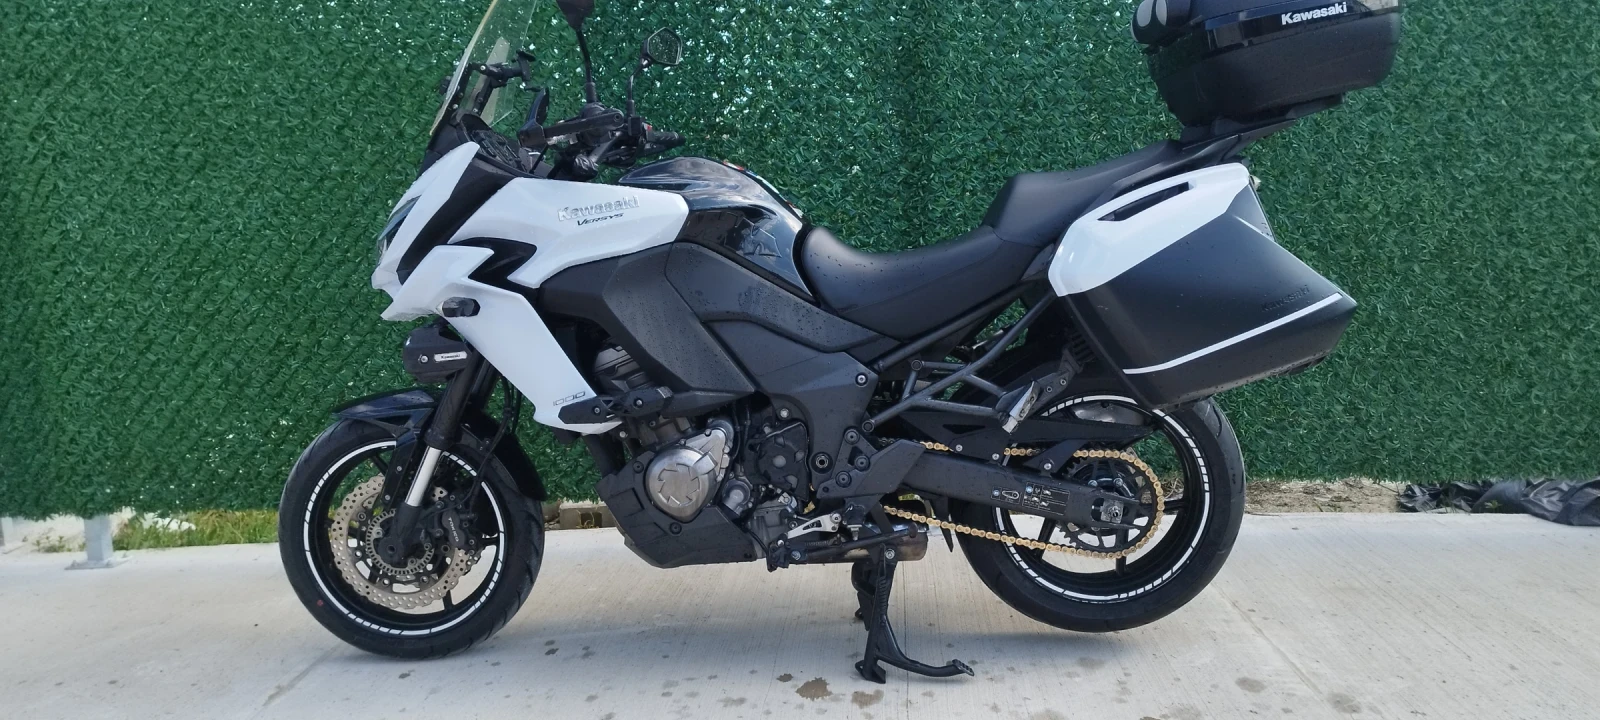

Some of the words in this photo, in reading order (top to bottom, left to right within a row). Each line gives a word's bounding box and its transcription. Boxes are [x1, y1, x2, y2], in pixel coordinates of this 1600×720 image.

[1281, 1, 1348, 26] Kawasaki
[557, 195, 640, 222] Kawasaki
[577, 212, 625, 226] VERSYS
[552, 390, 586, 407] 1000
